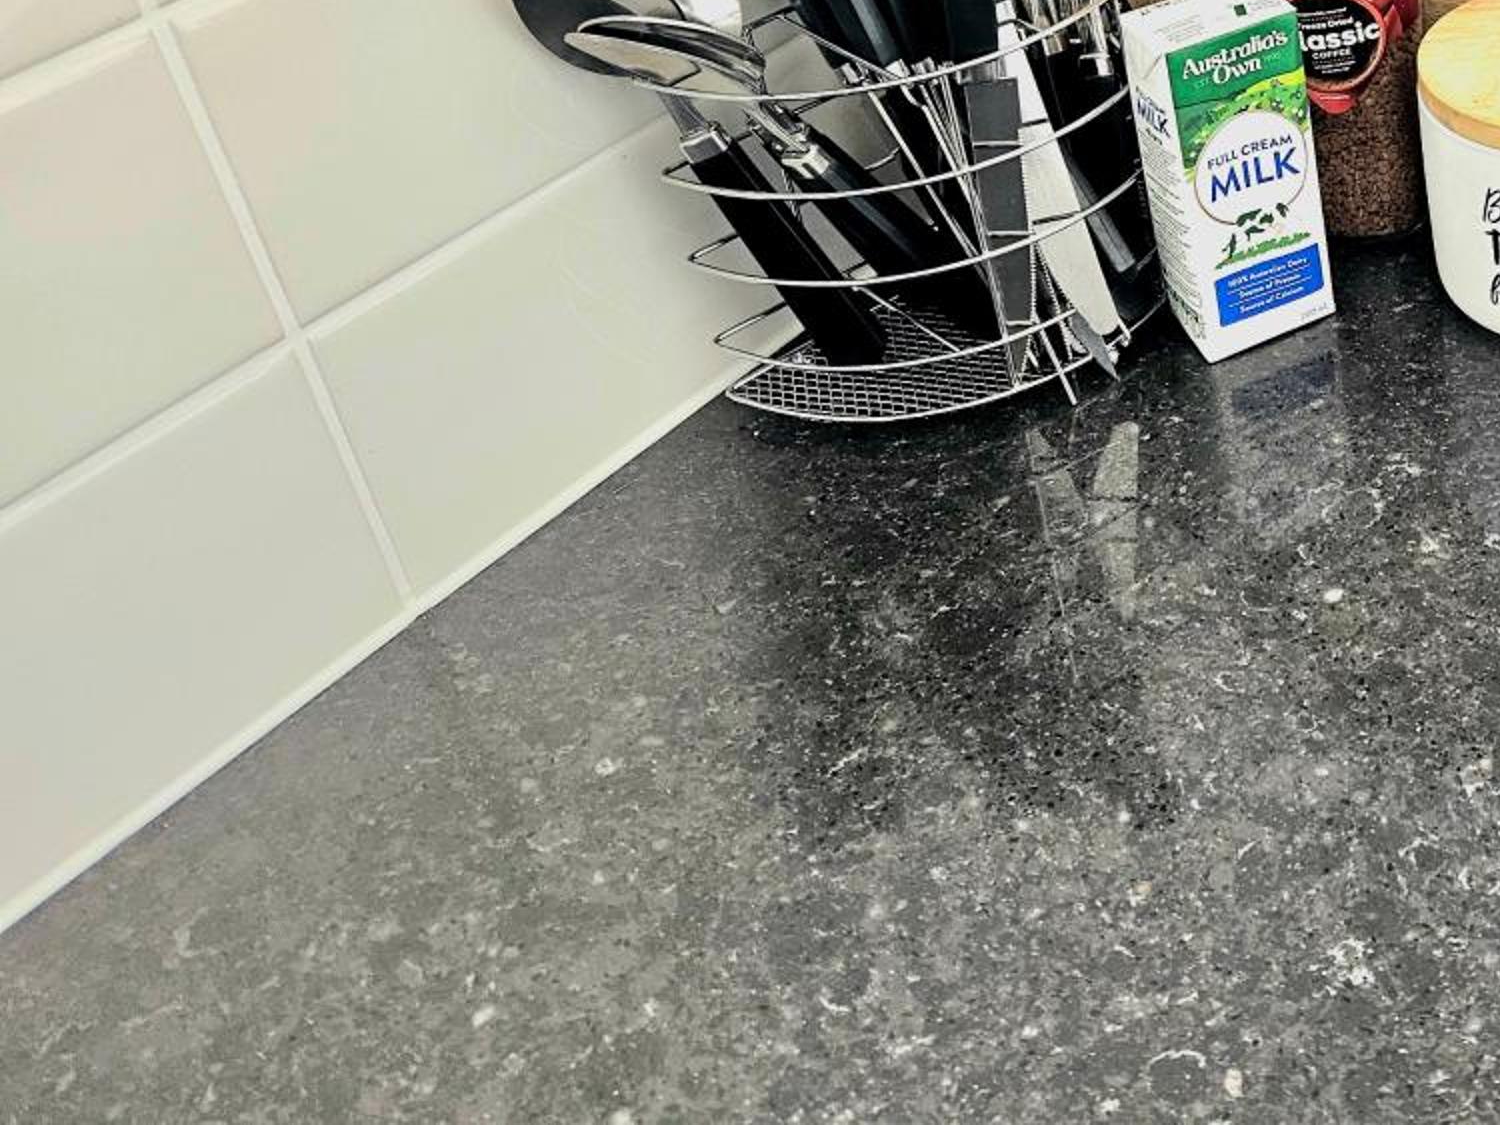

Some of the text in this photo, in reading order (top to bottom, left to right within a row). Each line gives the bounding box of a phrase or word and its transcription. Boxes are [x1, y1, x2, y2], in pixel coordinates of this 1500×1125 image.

[1183, 30, 1289, 80] Australia's
[1298, 21, 1381, 52] lassic
[1312, 46, 1351, 60] COFFEE
[1212, 58, 1263, 84] Own
[1137, 97, 1171, 139] MILK
[1207, 133, 1293, 171] FULL CREAM
[1211, 146, 1301, 204] MILK
